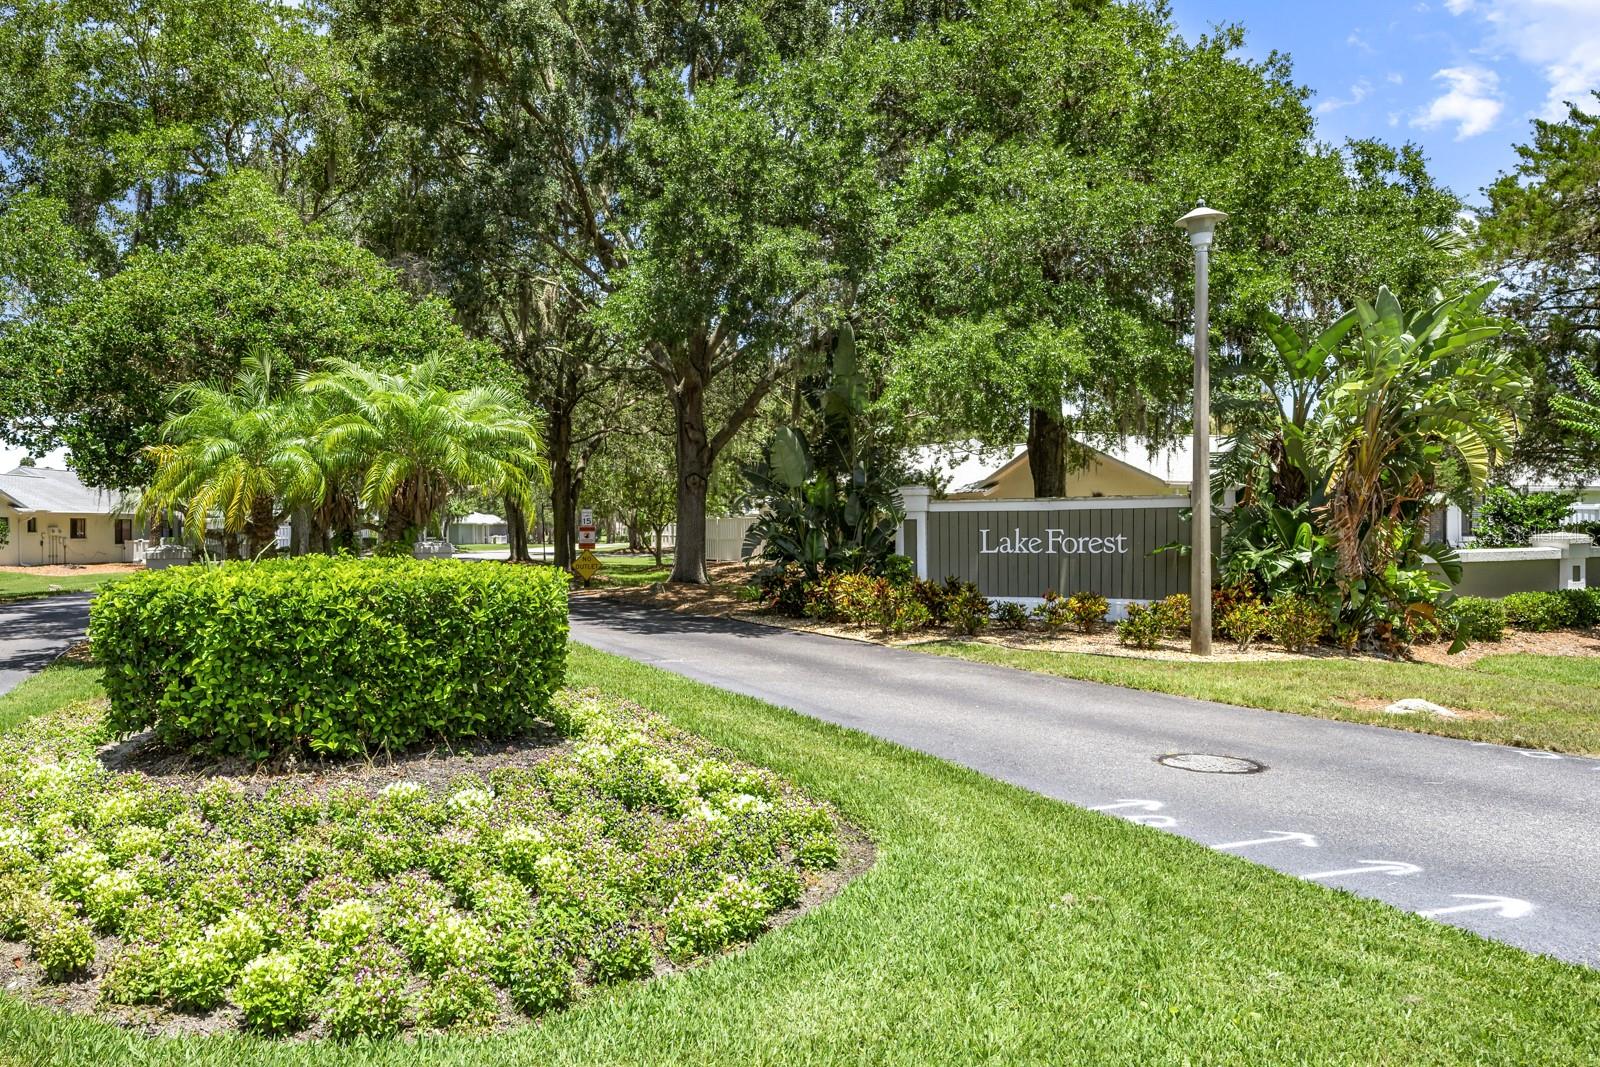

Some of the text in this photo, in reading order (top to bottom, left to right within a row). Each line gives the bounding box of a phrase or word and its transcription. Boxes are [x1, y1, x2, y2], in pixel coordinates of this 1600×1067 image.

[583, 517, 592, 525] 15
[979, 527, 1129, 554] Lake Forest
